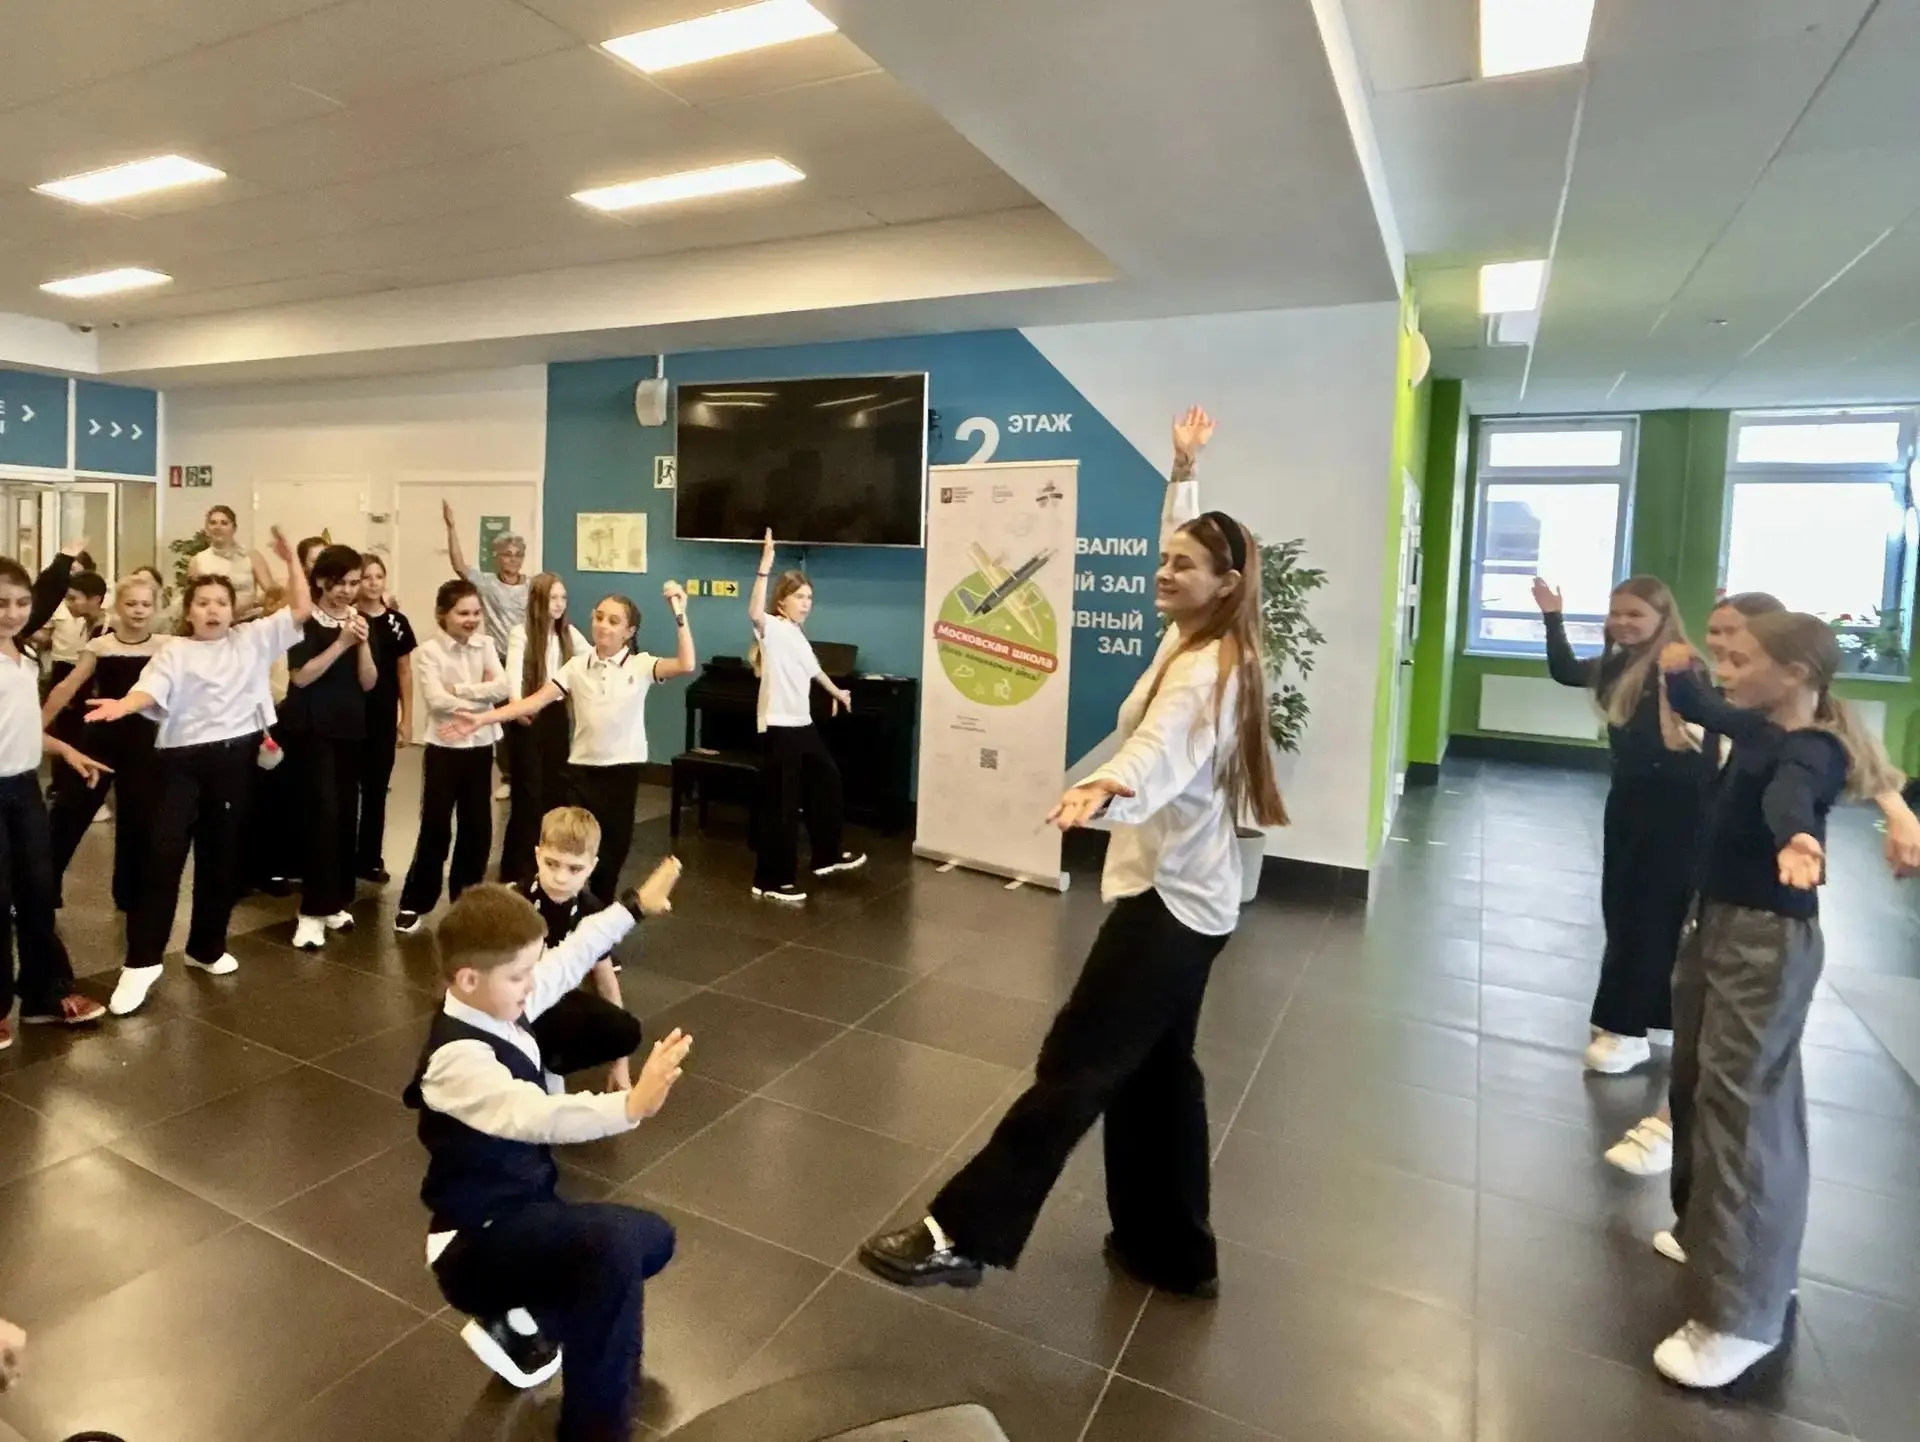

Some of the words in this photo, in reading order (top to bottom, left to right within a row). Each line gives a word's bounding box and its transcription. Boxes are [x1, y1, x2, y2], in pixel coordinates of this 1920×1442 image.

[955, 416, 1000, 464] 2
[1007, 413, 1073, 433] ЭТАЖ
[1100, 574, 1146, 594] ЗАЛ
[1097, 635, 1142, 657] ЗАЛ
